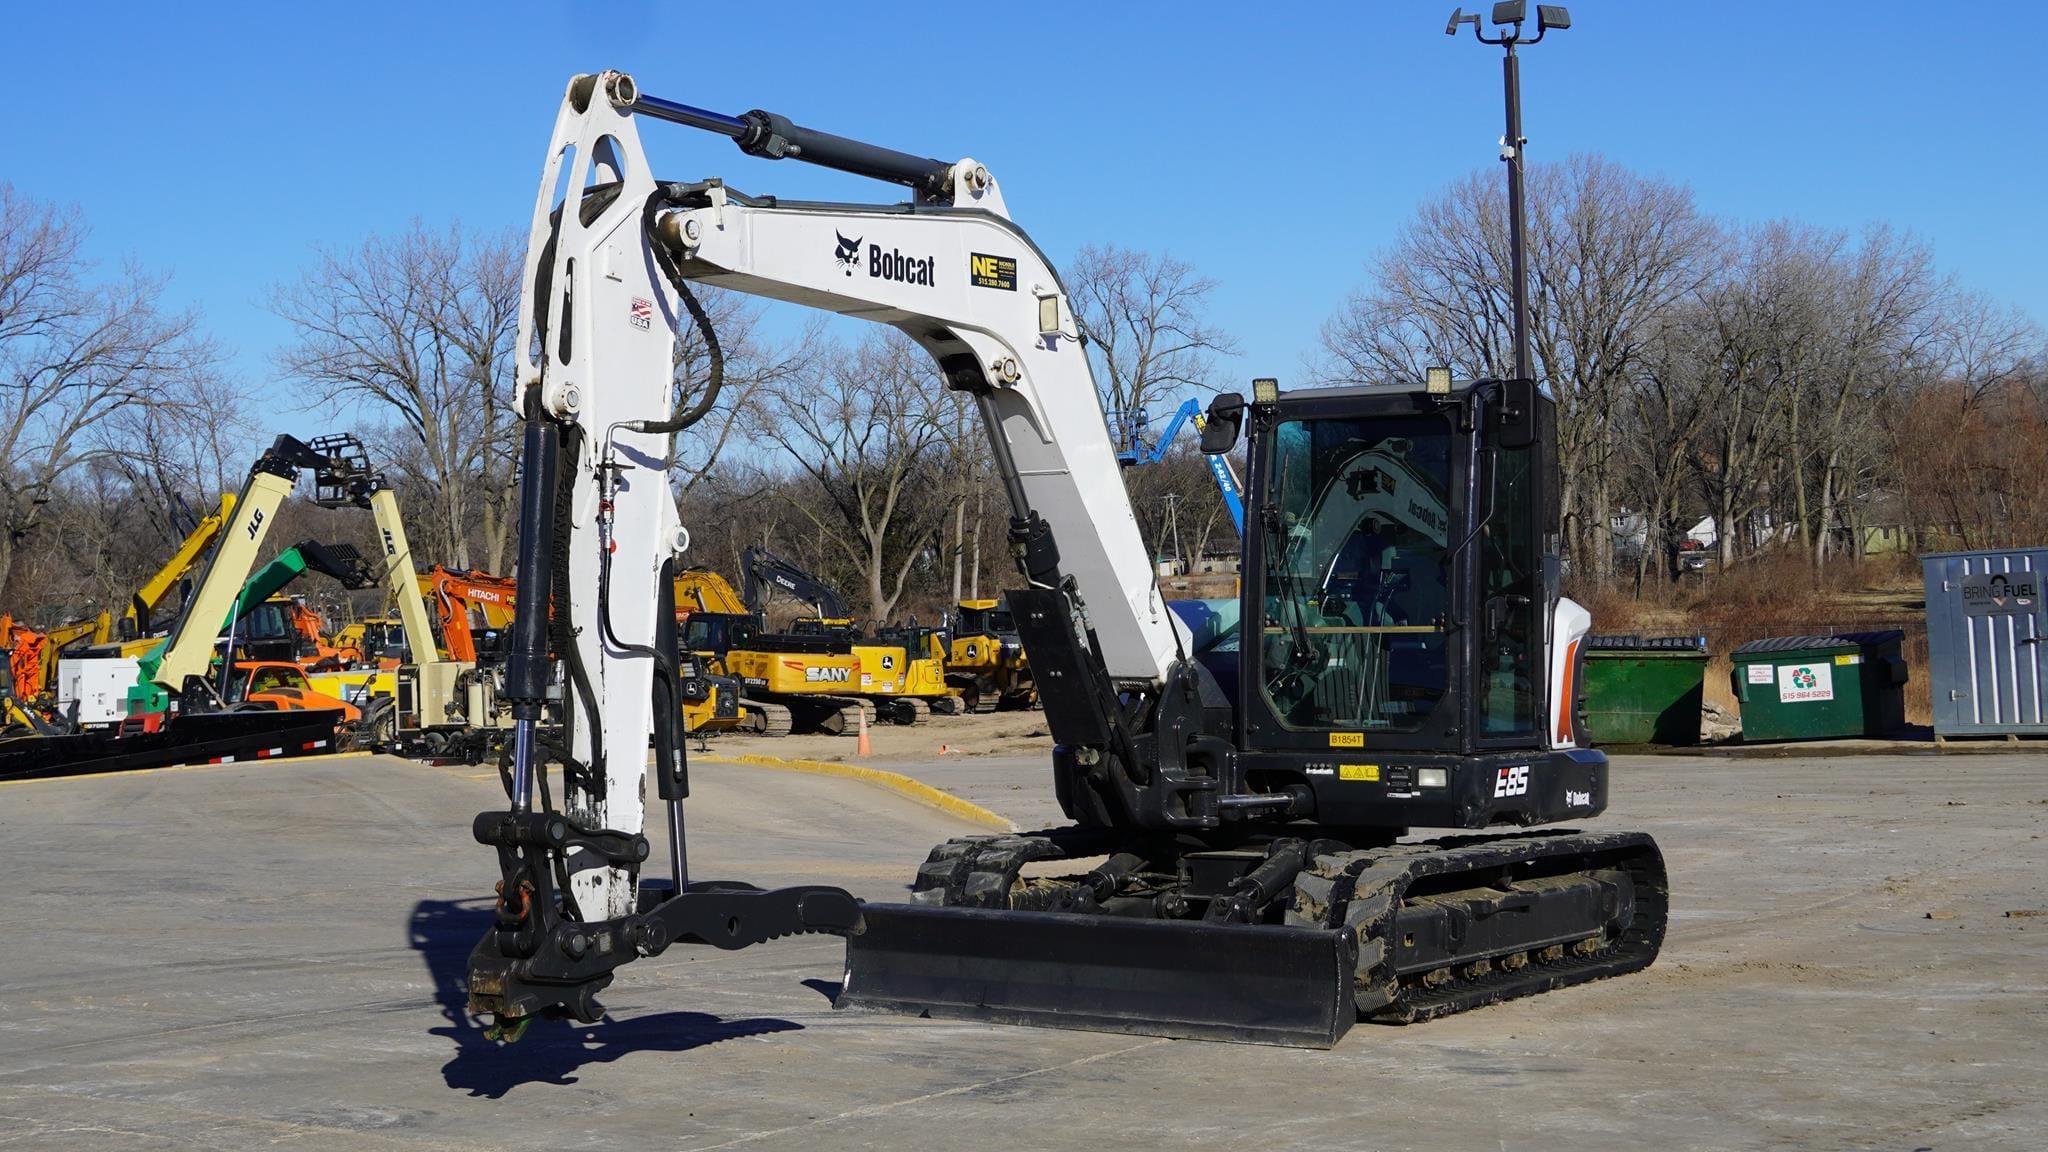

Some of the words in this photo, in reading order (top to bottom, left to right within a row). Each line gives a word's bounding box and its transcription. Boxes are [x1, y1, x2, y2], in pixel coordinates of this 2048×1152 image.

[869, 243, 935, 287] Bobcat
[972, 255, 998, 278] NE
[978, 277, 1010, 288] 515.280.7600
[631, 316, 649, 328] USA
[247, 508, 264, 540] JLG
[382, 528, 396, 554] JLG
[776, 575, 796, 590] DEERE
[467, 588, 500, 602] HITACHI
[1964, 585, 2000, 600] BRING
[2003, 584, 2037, 597] FUEL
[806, 666, 851, 682] SANY
[1331, 735, 1362, 744] B1854T
[1494, 765, 1529, 798] E85
